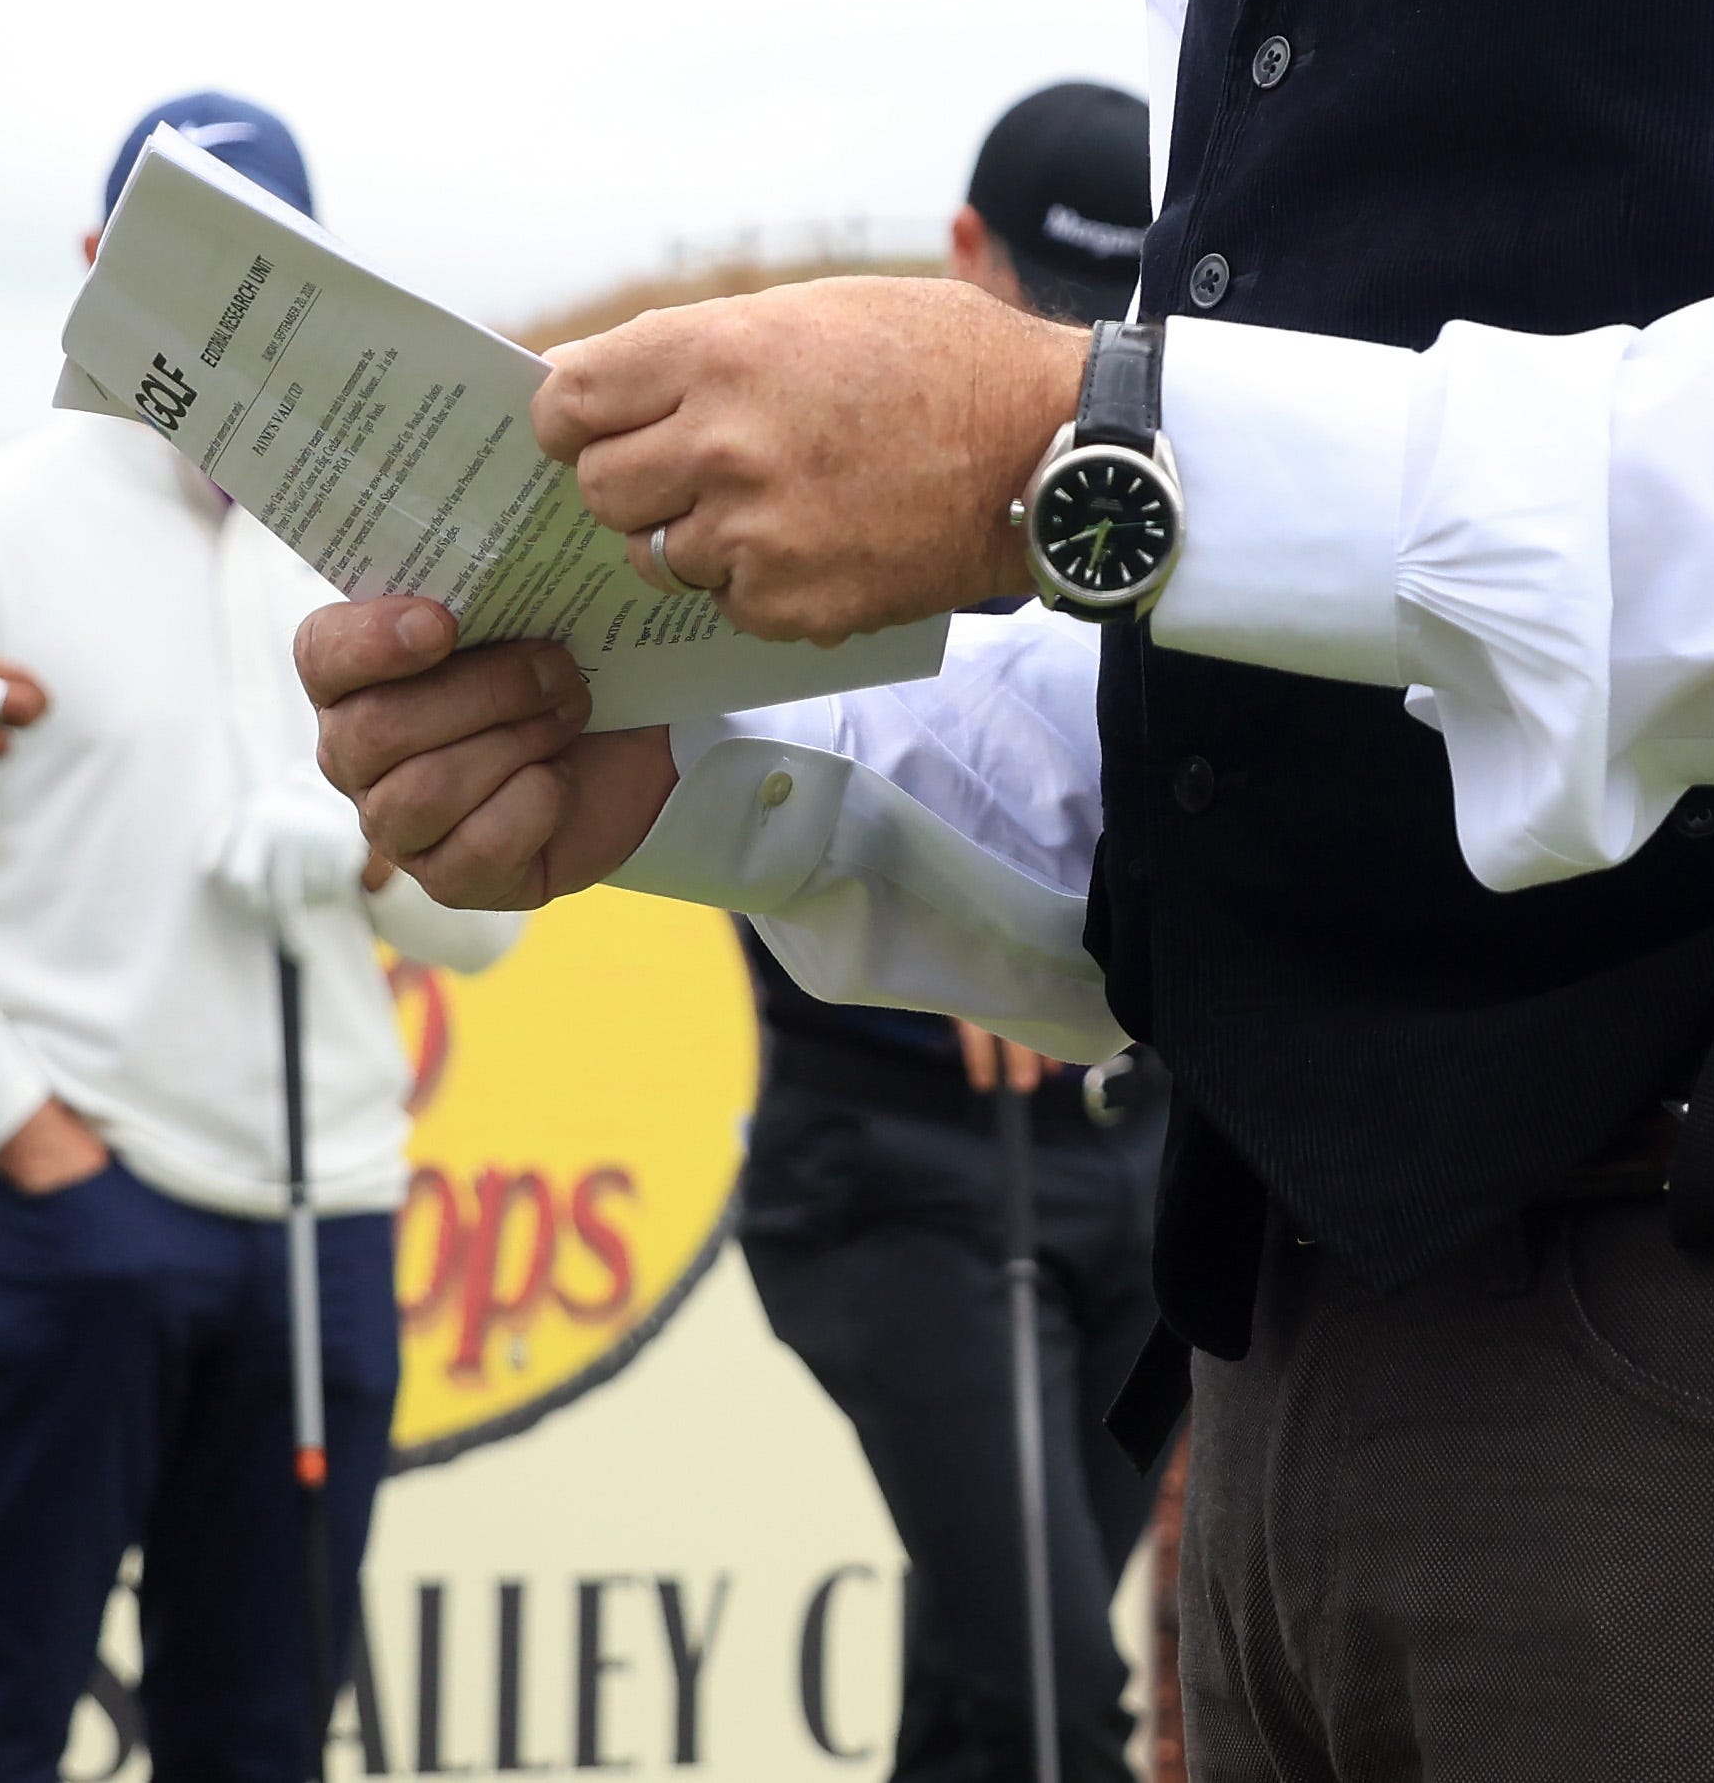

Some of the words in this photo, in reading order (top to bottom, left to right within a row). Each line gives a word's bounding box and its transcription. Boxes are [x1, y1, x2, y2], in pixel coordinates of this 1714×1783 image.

[218, 280, 261, 334] RESEARCH
[247, 255, 276, 285] UNIT
[135, 352, 198, 431] GOLF
[394, 1162, 636, 1384] ops
[320, 1570, 726, 1776] ALLEY
